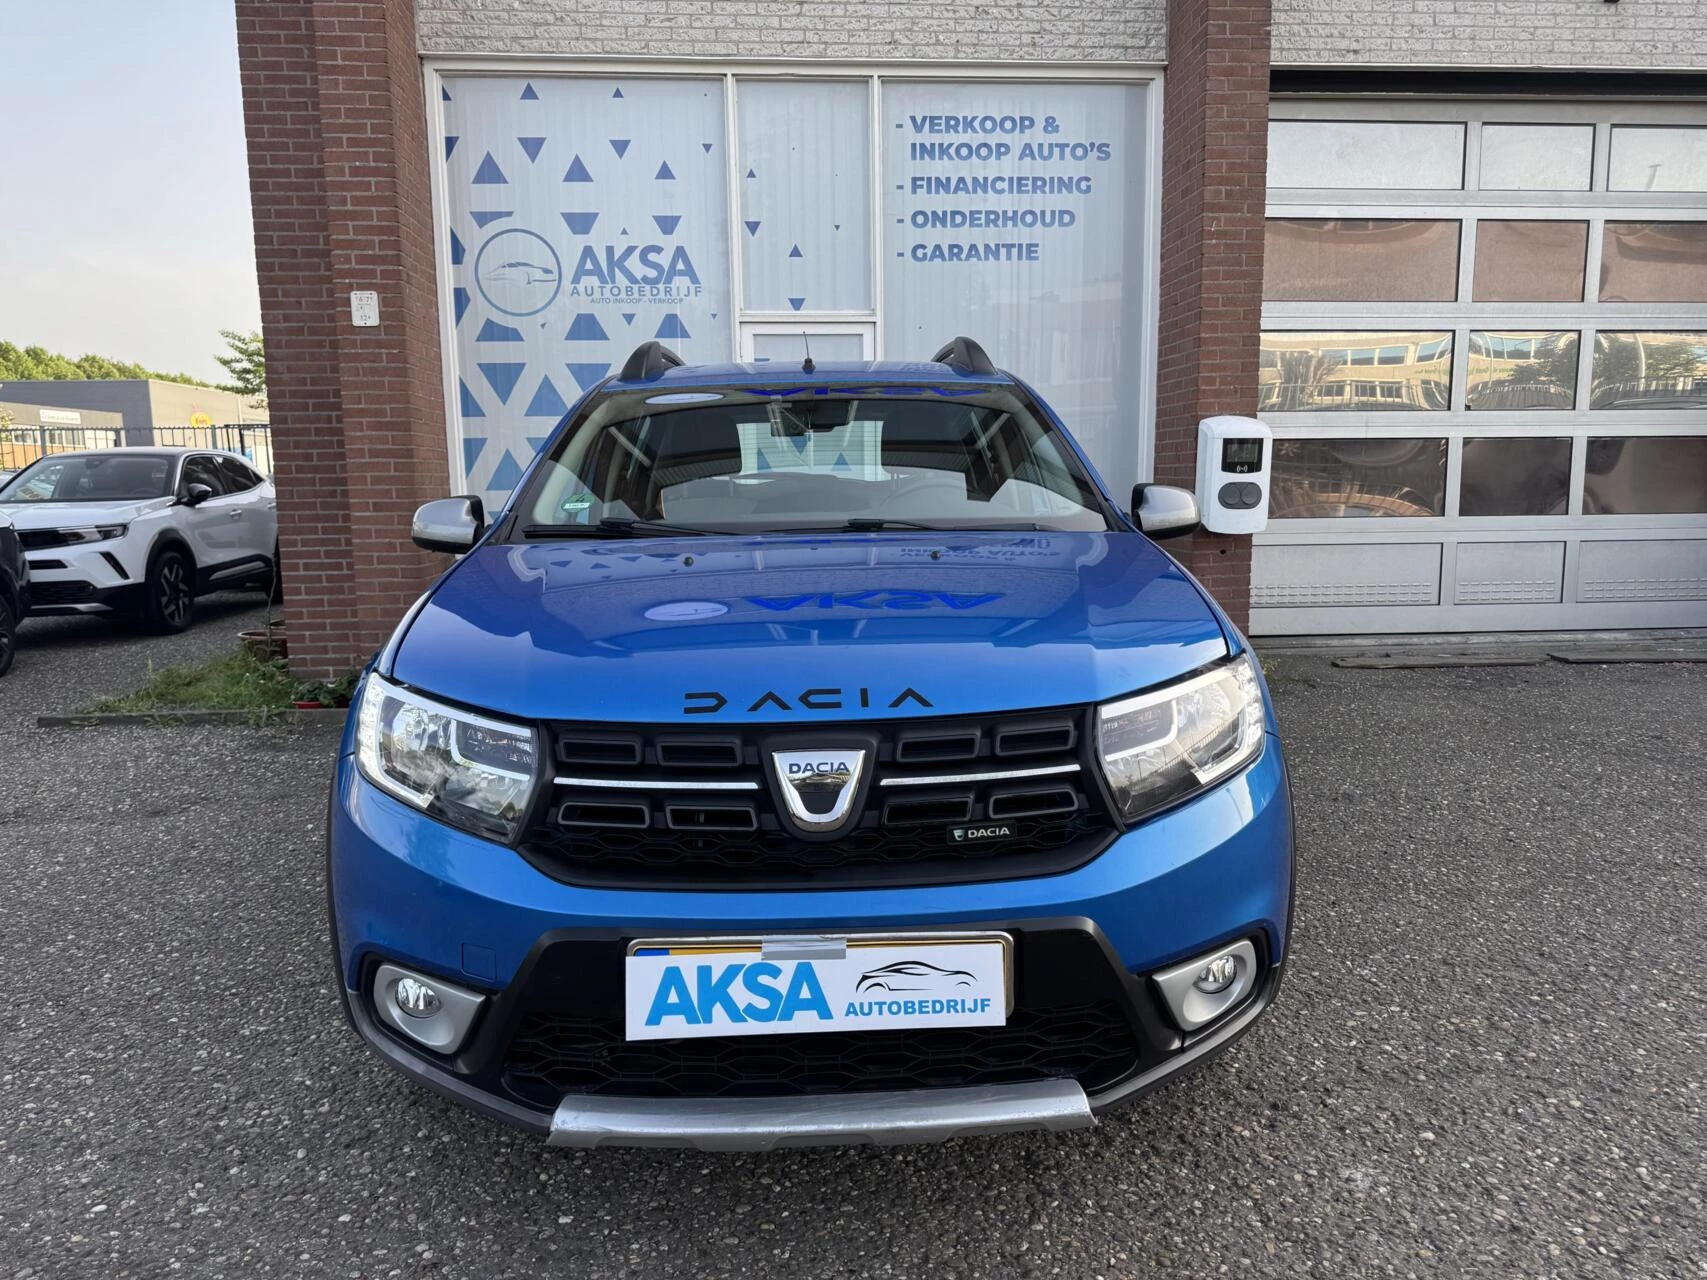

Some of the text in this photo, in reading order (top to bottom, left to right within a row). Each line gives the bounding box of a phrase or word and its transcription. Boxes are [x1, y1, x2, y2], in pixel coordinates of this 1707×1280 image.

[909, 116, 1035, 134] VERKOOP
[1043, 116, 1060, 134] &
[910, 142, 1111, 161] INKOOP AUTO'S
[910, 176, 1092, 195] FINANCIERING
[910, 209, 1076, 228] ONDERHOUD
[910, 243, 1039, 262] GARANTIE
[570, 244, 701, 285] AKSA
[570, 285, 703, 297] AUTOBEDRIJF
[683, 687, 934, 715] DACIA
[788, 761, 850, 774] DACIA
[967, 827, 1010, 839] DACIA
[645, 961, 991, 1026] AKSA AUTOBEDRIJF
